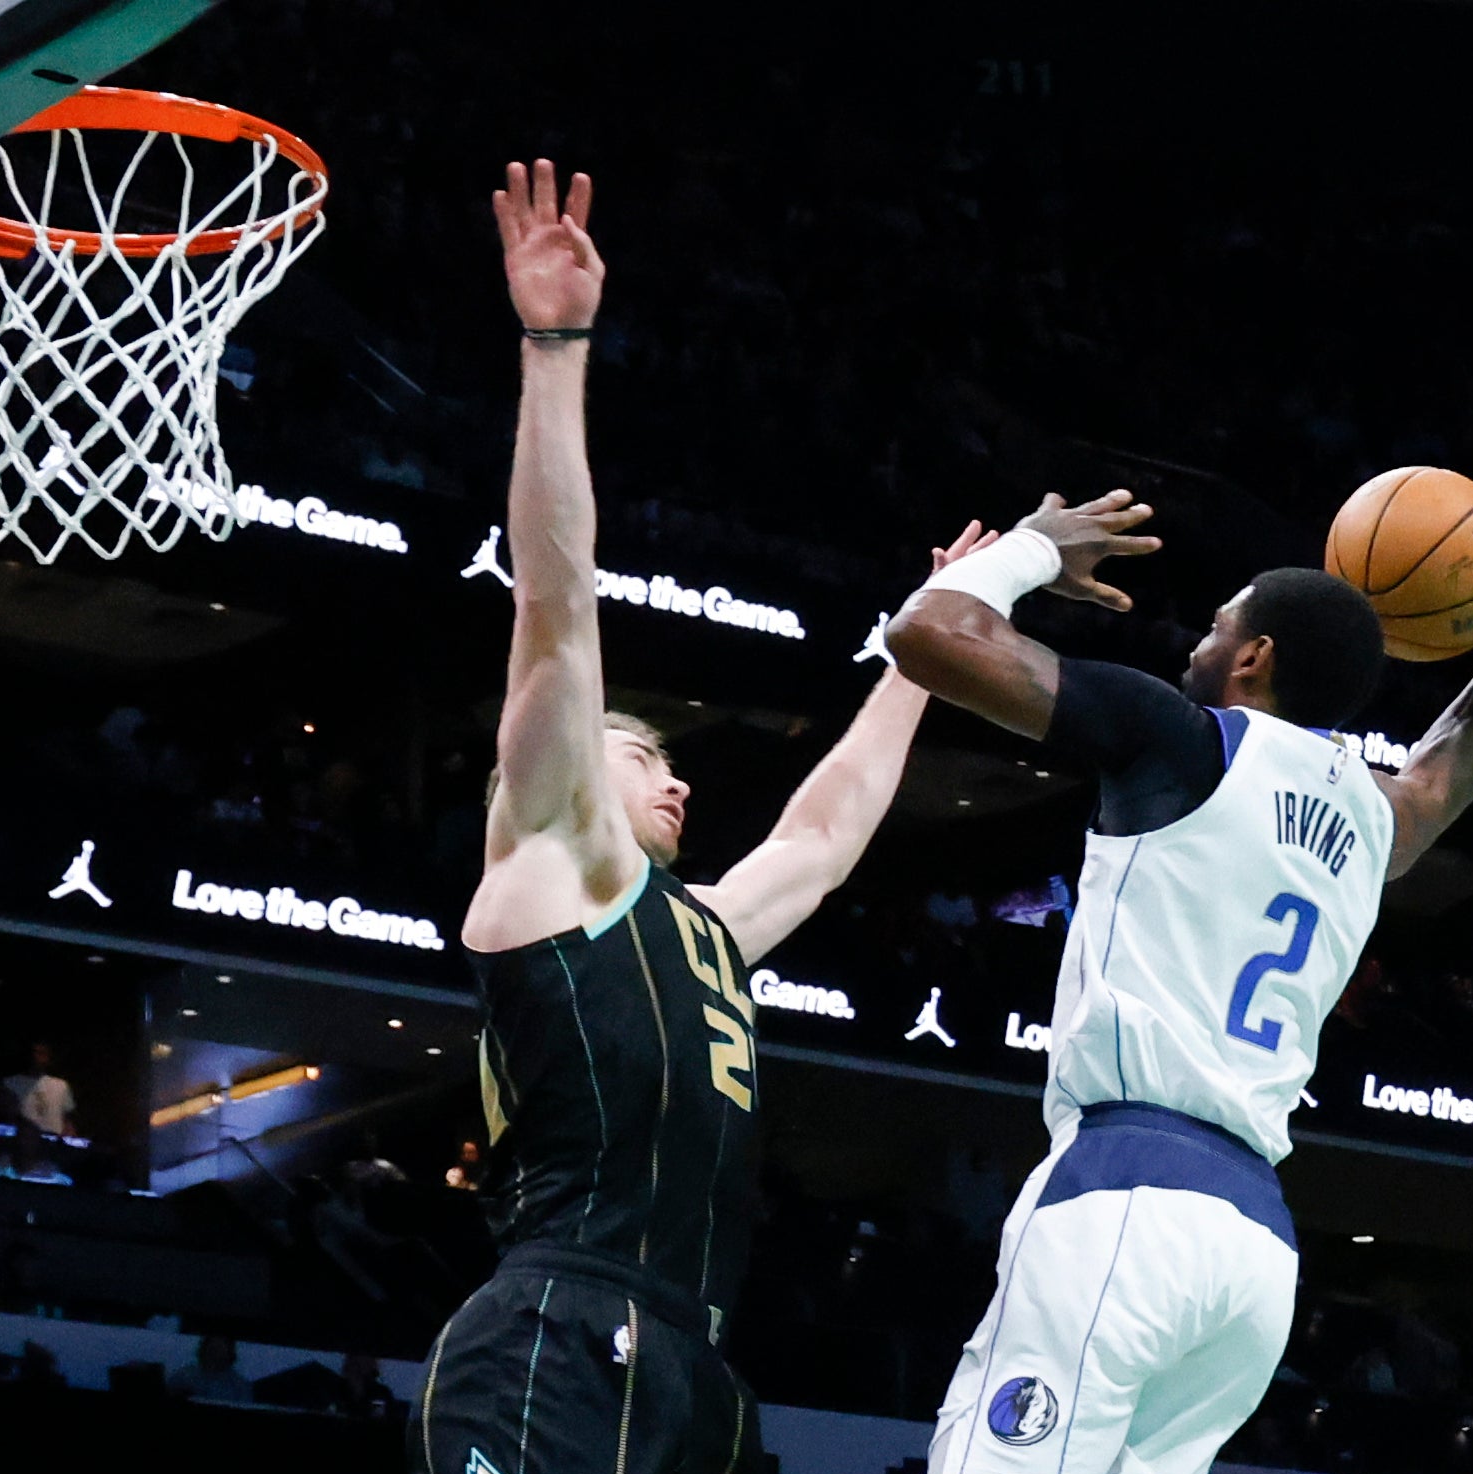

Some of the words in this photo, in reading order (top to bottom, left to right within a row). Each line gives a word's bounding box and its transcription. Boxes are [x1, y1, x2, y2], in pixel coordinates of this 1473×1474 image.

[976, 57, 1053, 96] 211
[294, 496, 407, 553] Game.
[594, 570, 648, 604] ove
[648, 575, 703, 616] the
[703, 586, 805, 639] Game.
[1364, 732, 1409, 768] the
[1275, 791, 1356, 878] IRVING
[172, 868, 265, 921] Love
[265, 885, 328, 930] the
[328, 895, 446, 951] Game.
[663, 890, 754, 1029] CL
[1225, 891, 1320, 1054] 2
[750, 968, 855, 1019] Game.
[702, 1002, 753, 1113] 2
[1005, 1011, 1052, 1052] Lo
[1362, 1074, 1430, 1116] Love
